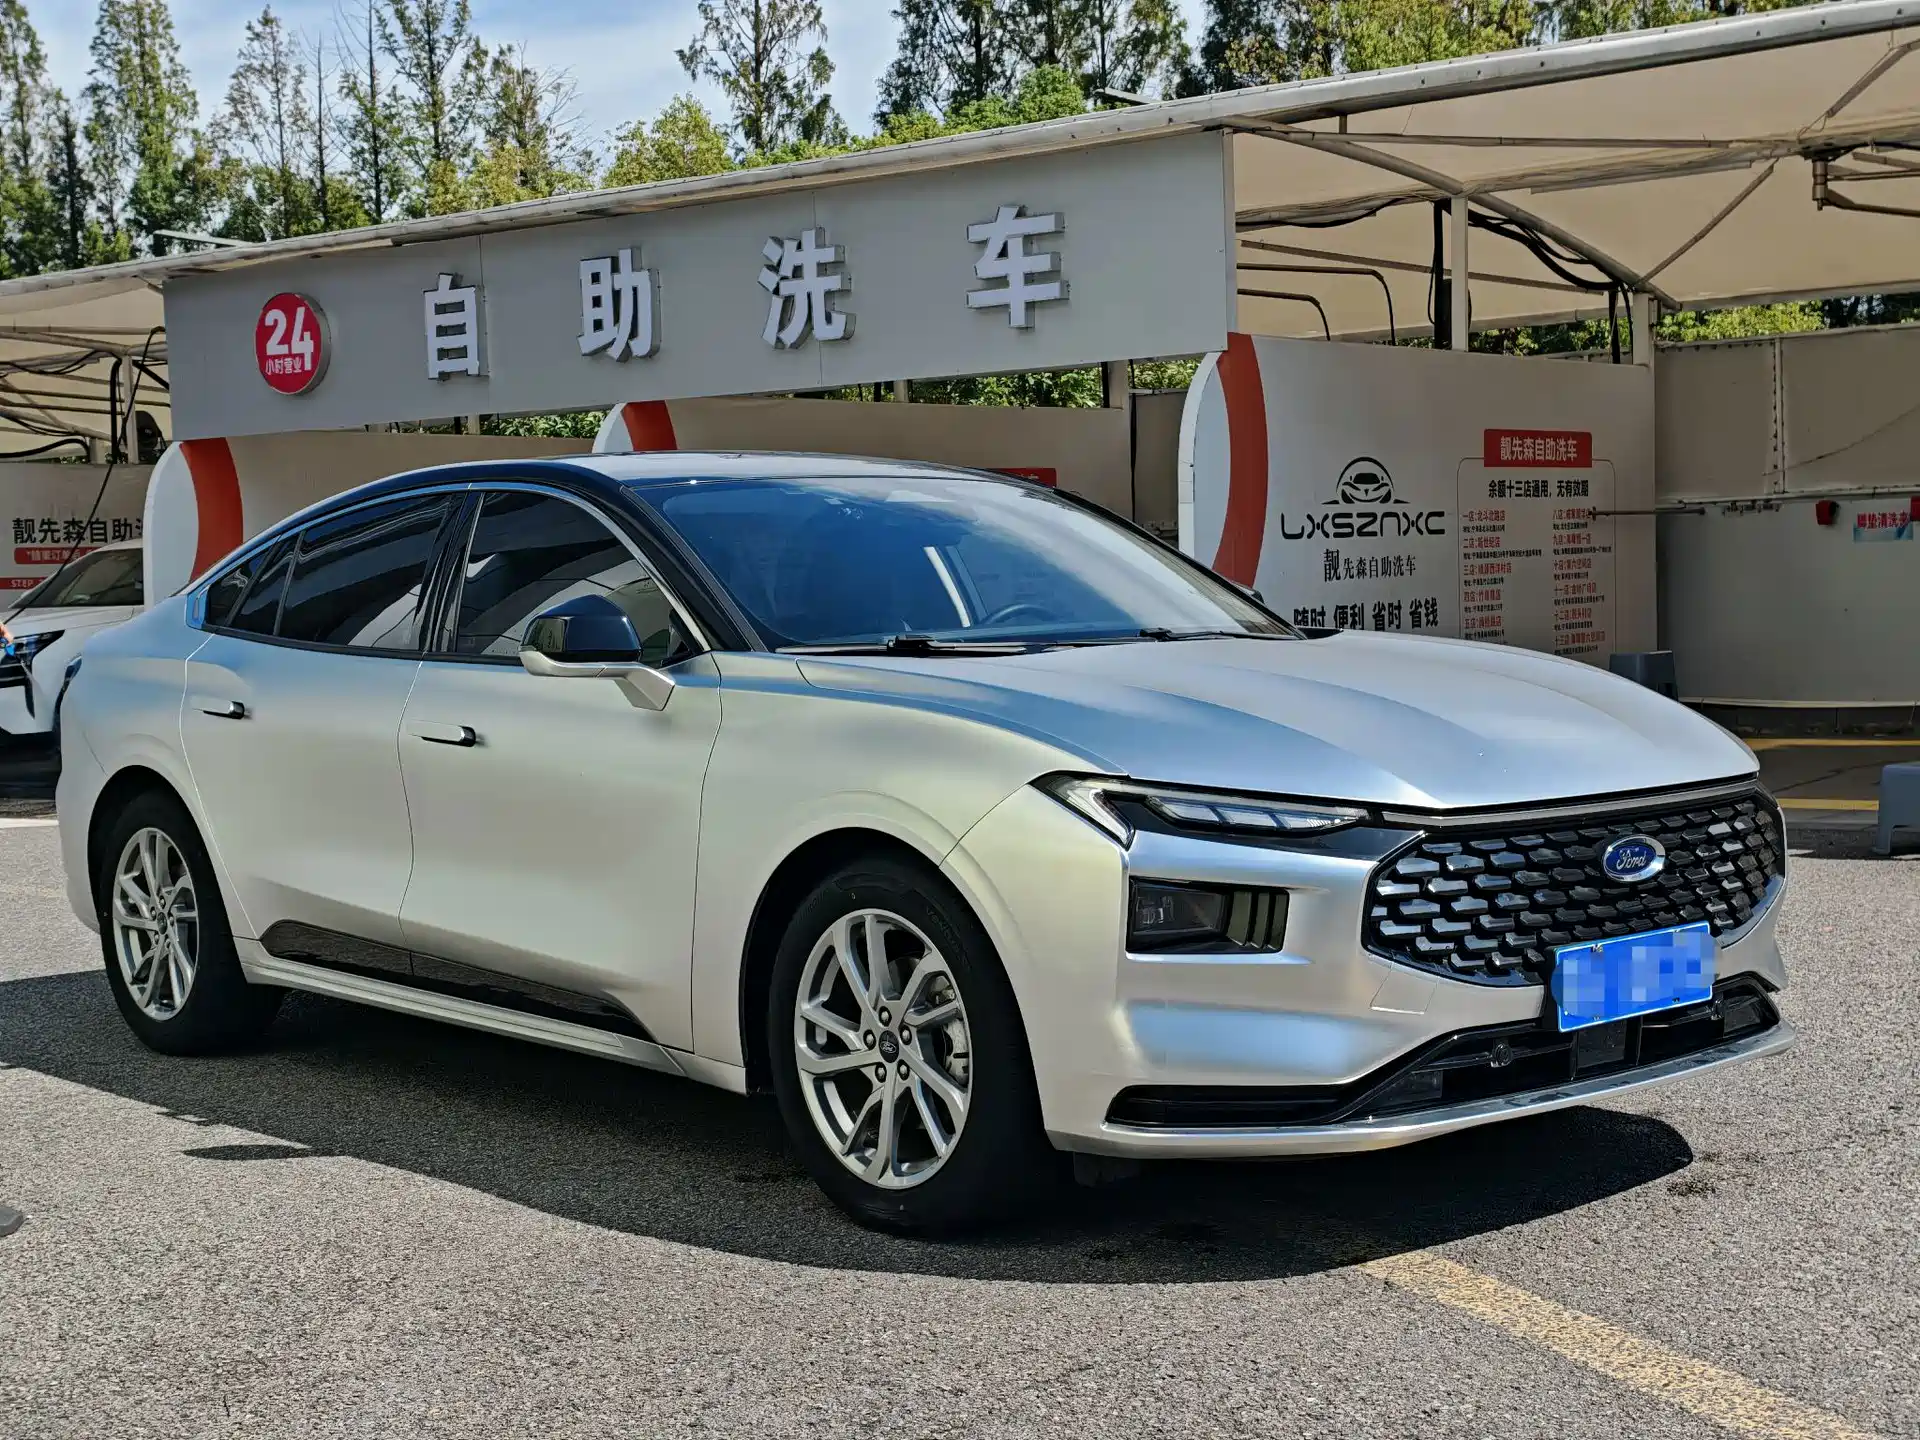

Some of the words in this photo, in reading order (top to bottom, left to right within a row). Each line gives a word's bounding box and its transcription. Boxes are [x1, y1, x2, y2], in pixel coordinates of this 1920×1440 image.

[265, 306, 314, 371] 24
[265, 356, 302, 375] 小时营业
[1500, 436, 1578, 462] 靓先森自助洗车
[1323, 548, 1416, 582] 靓先森自助洗车
[11, 579, 34, 588] STEP
[1293, 605, 1326, 628] 随时
[1333, 602, 1365, 630] 便利
[1372, 599, 1402, 631] 省时
[1409, 597, 1439, 629] 省钱
[1616, 849, 1647, 870] Ford
